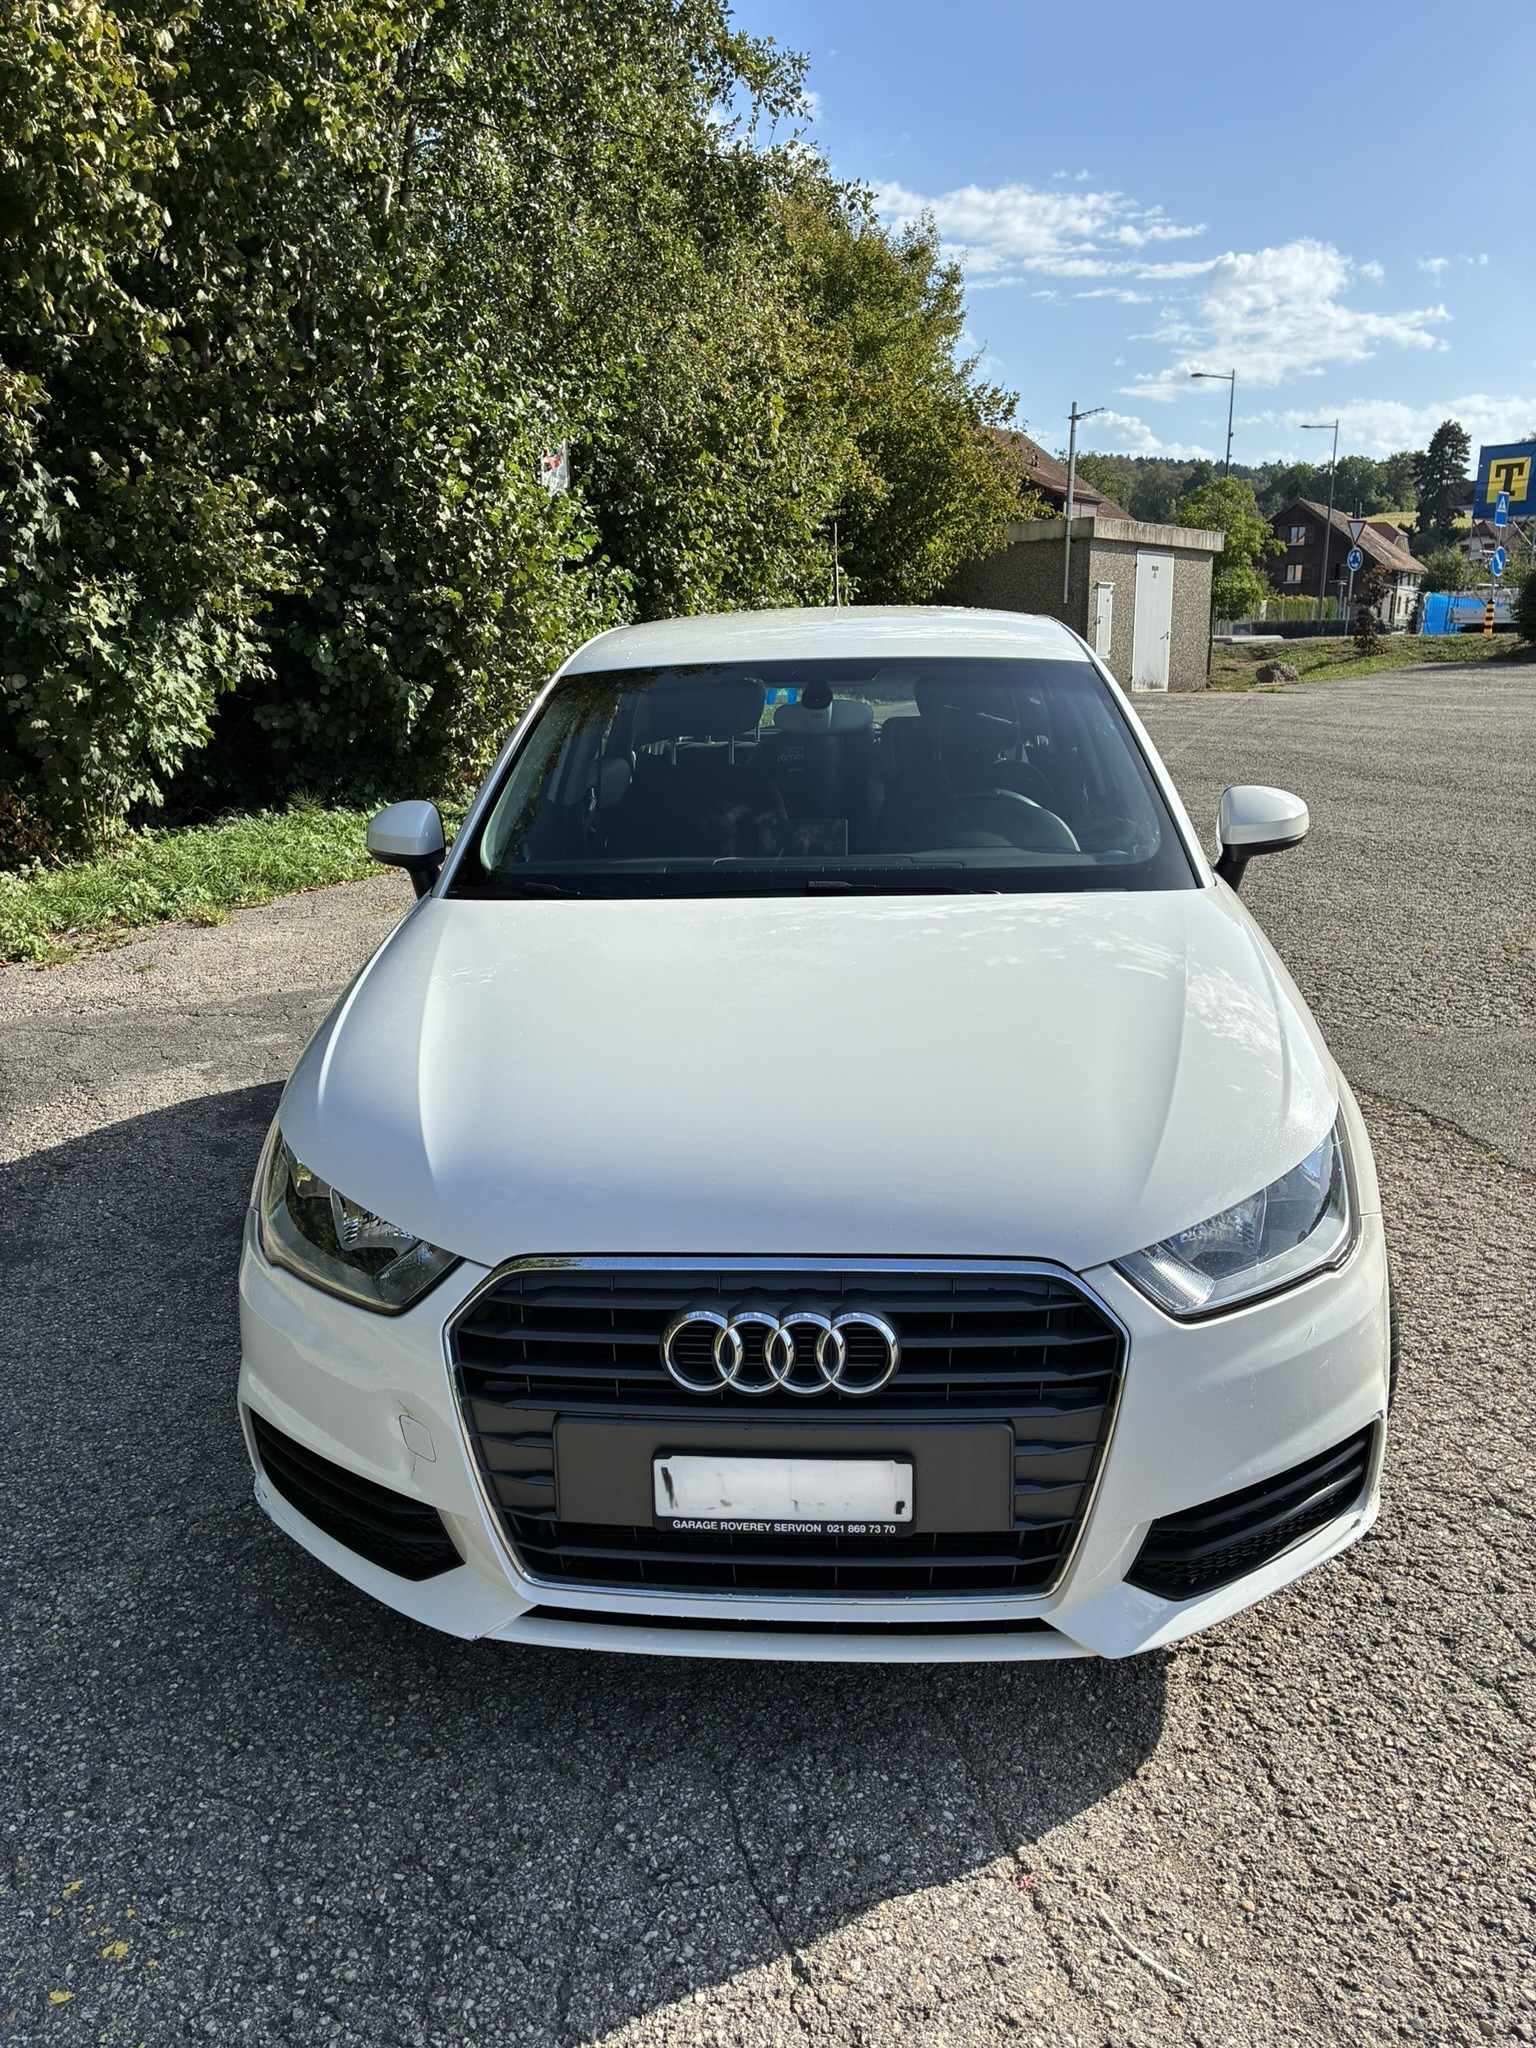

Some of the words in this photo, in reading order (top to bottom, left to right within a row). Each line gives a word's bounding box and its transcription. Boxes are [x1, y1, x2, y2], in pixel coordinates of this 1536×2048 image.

[1495, 462, 1525, 496] T
[672, 1519, 718, 1530] GARAGE
[720, 1521, 771, 1532] ROVEREY
[773, 1523, 822, 1534] SERVION
[827, 1524, 845, 1534] 021
[847, 1524, 866, 1534] 869
[868, 1525, 882, 1534] 73
[883, 1525, 896, 1534] 70
